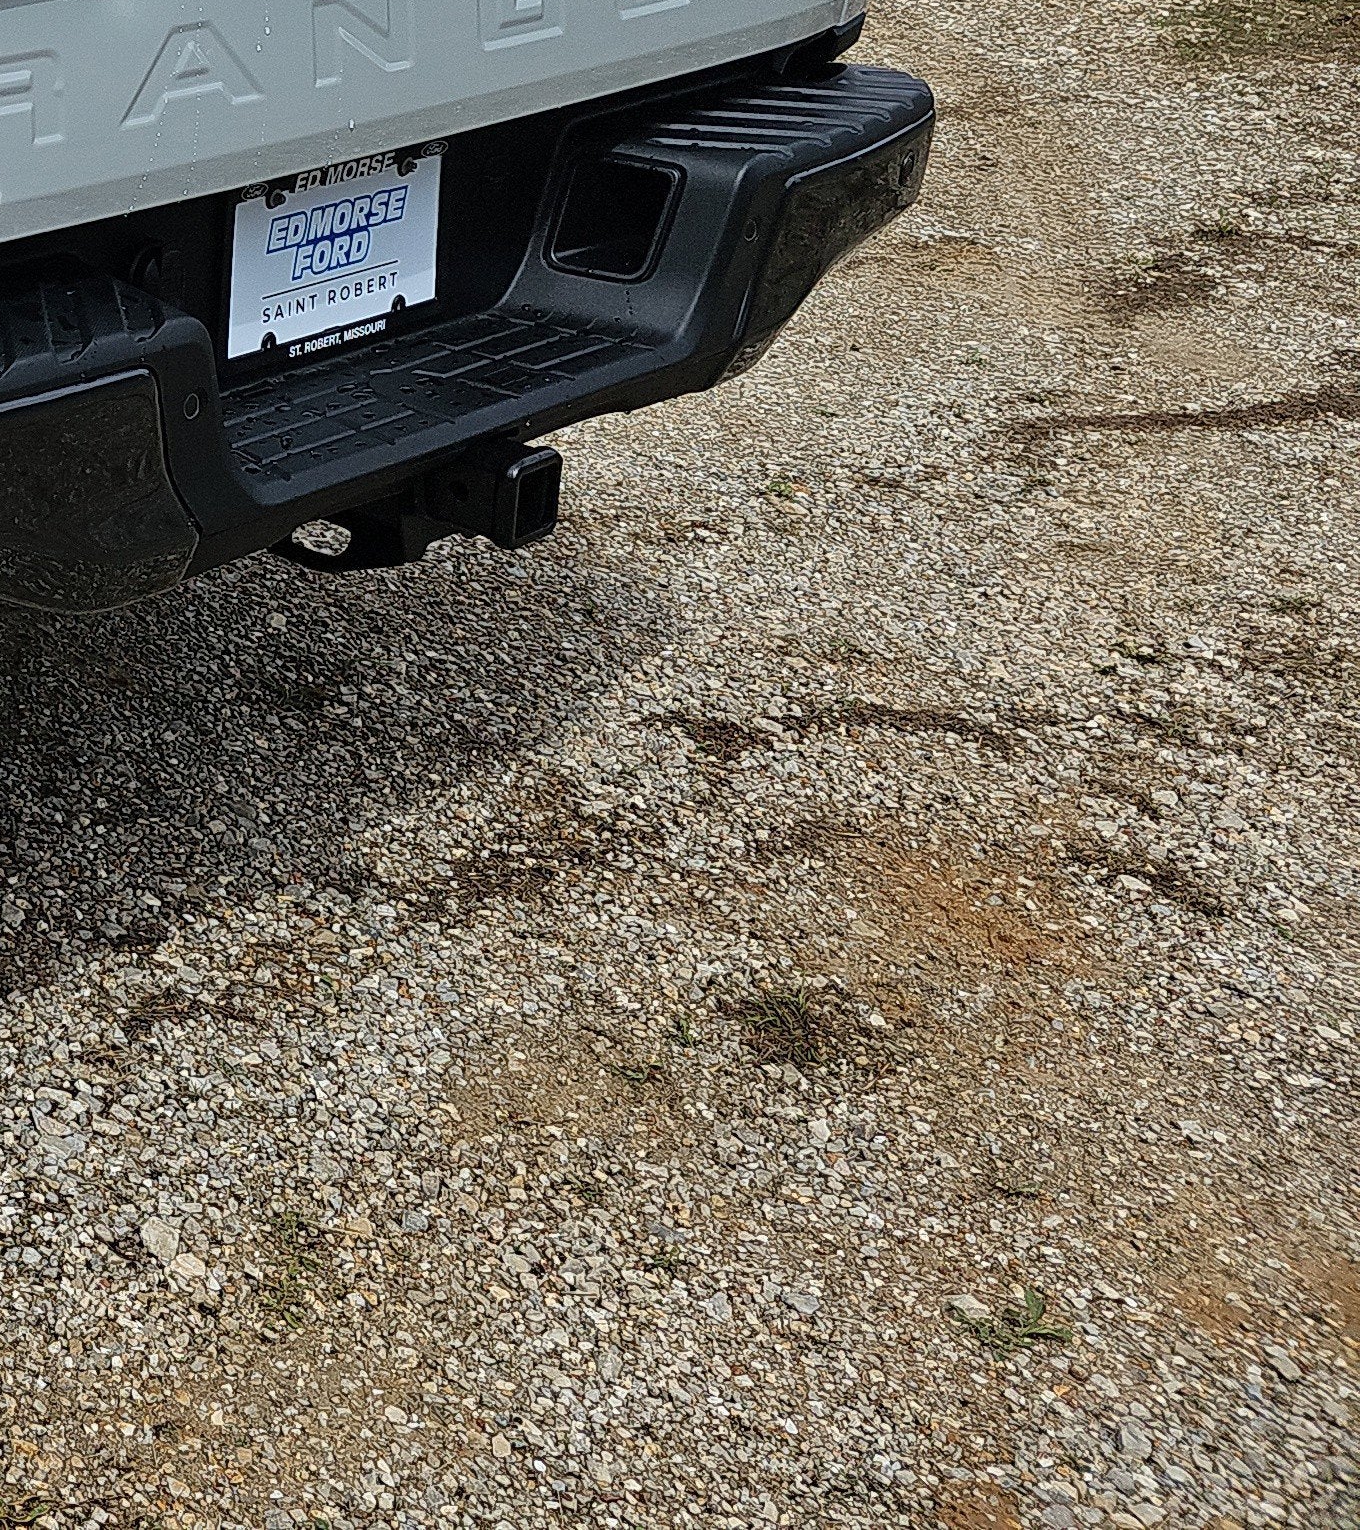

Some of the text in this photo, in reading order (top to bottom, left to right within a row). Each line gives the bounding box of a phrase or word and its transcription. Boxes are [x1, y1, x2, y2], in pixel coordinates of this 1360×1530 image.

[294, 151, 397, 194] ED MORSE
[266, 185, 409, 254] ED MORSE
[292, 227, 371, 281] FORD
[262, 271, 398, 324] SAINT ROBERT
[288, 319, 387, 358] ST. ROBERT, MISSOURI
